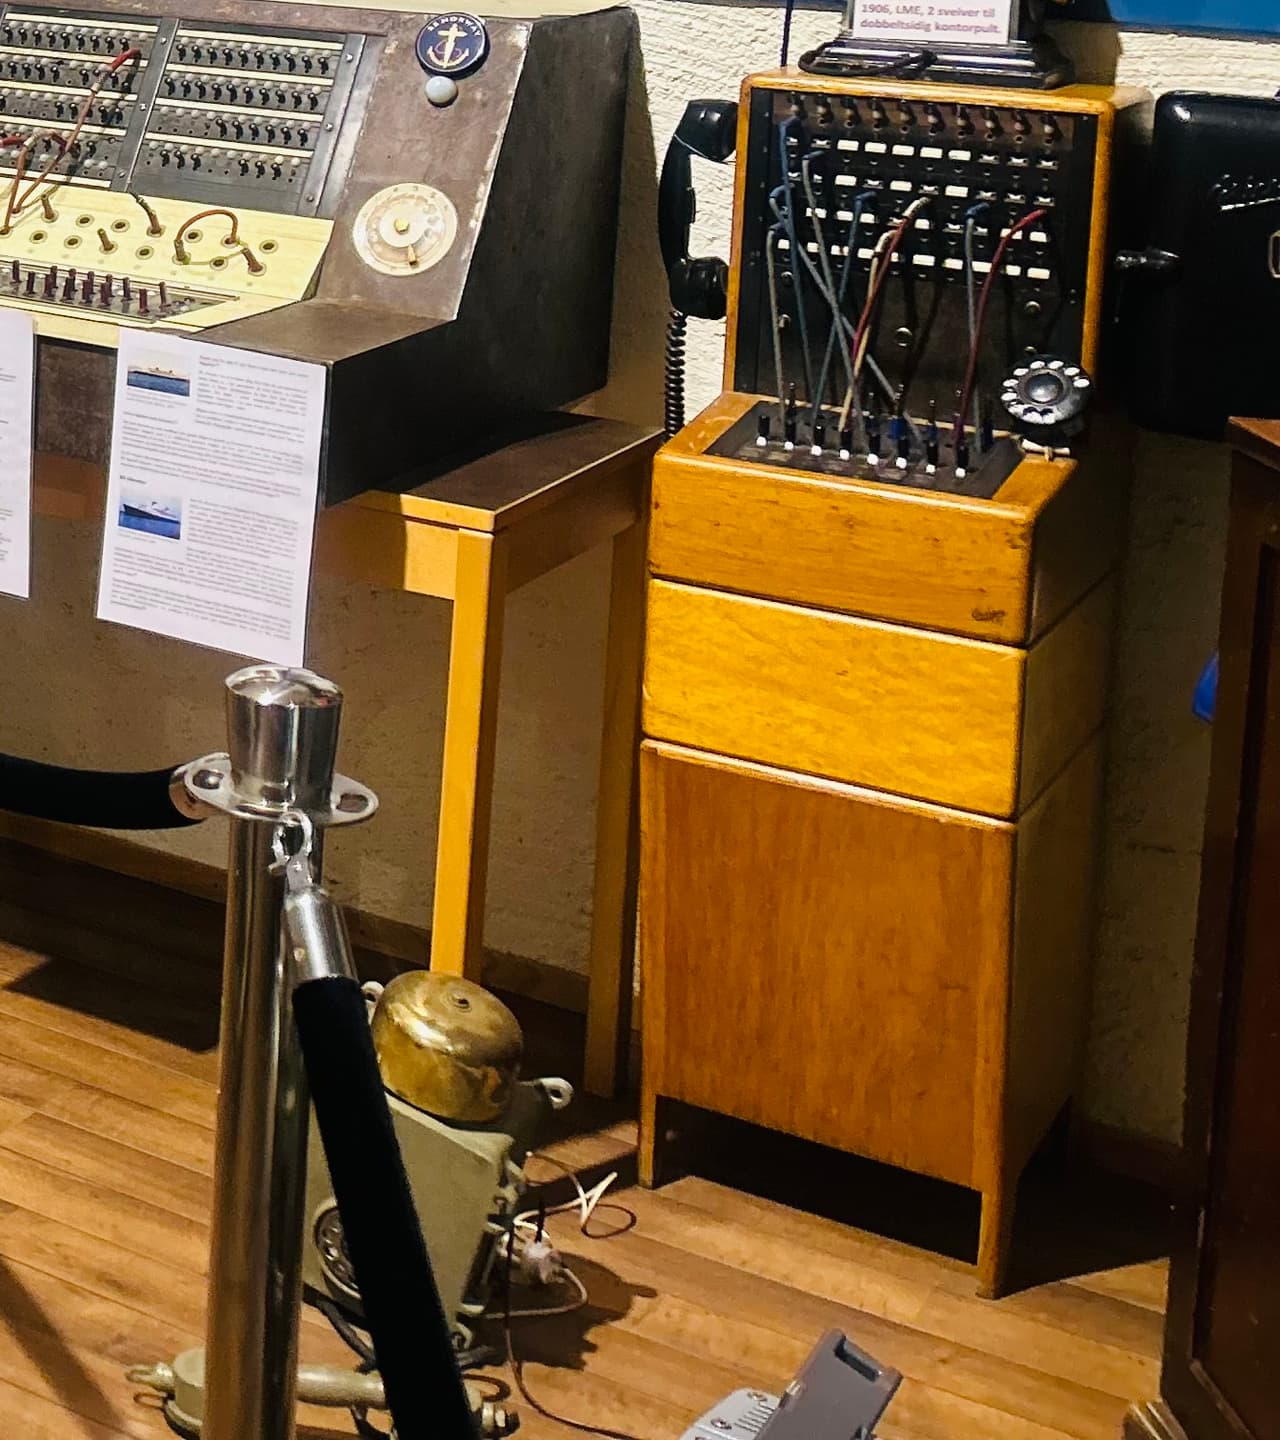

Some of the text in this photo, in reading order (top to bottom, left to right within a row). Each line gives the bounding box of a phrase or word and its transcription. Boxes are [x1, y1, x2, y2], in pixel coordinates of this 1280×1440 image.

[927, 6, 935, 16] 2
[982, 8, 996, 18] til
[441, 15, 481, 36] NORWAY
[860, 19, 1002, 34] dobbeltsidig kontorpult.
